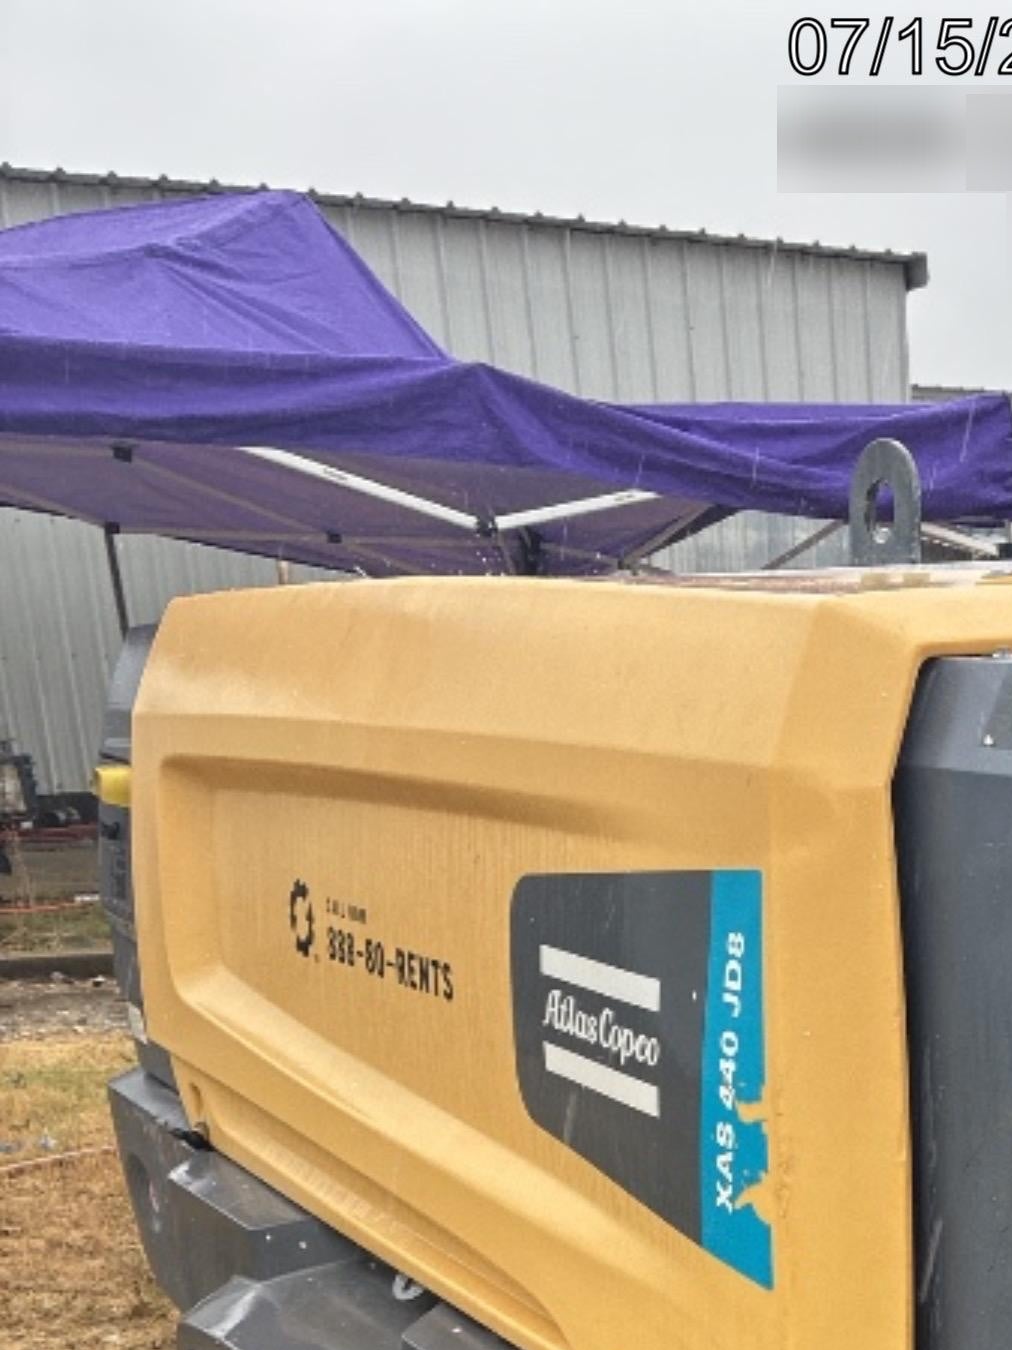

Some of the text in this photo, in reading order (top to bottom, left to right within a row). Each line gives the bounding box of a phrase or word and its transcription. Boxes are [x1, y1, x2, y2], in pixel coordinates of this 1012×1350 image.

[542, 989, 660, 1066] Atlas Copco
[716, 931, 745, 1215] XAS 440 JD8
